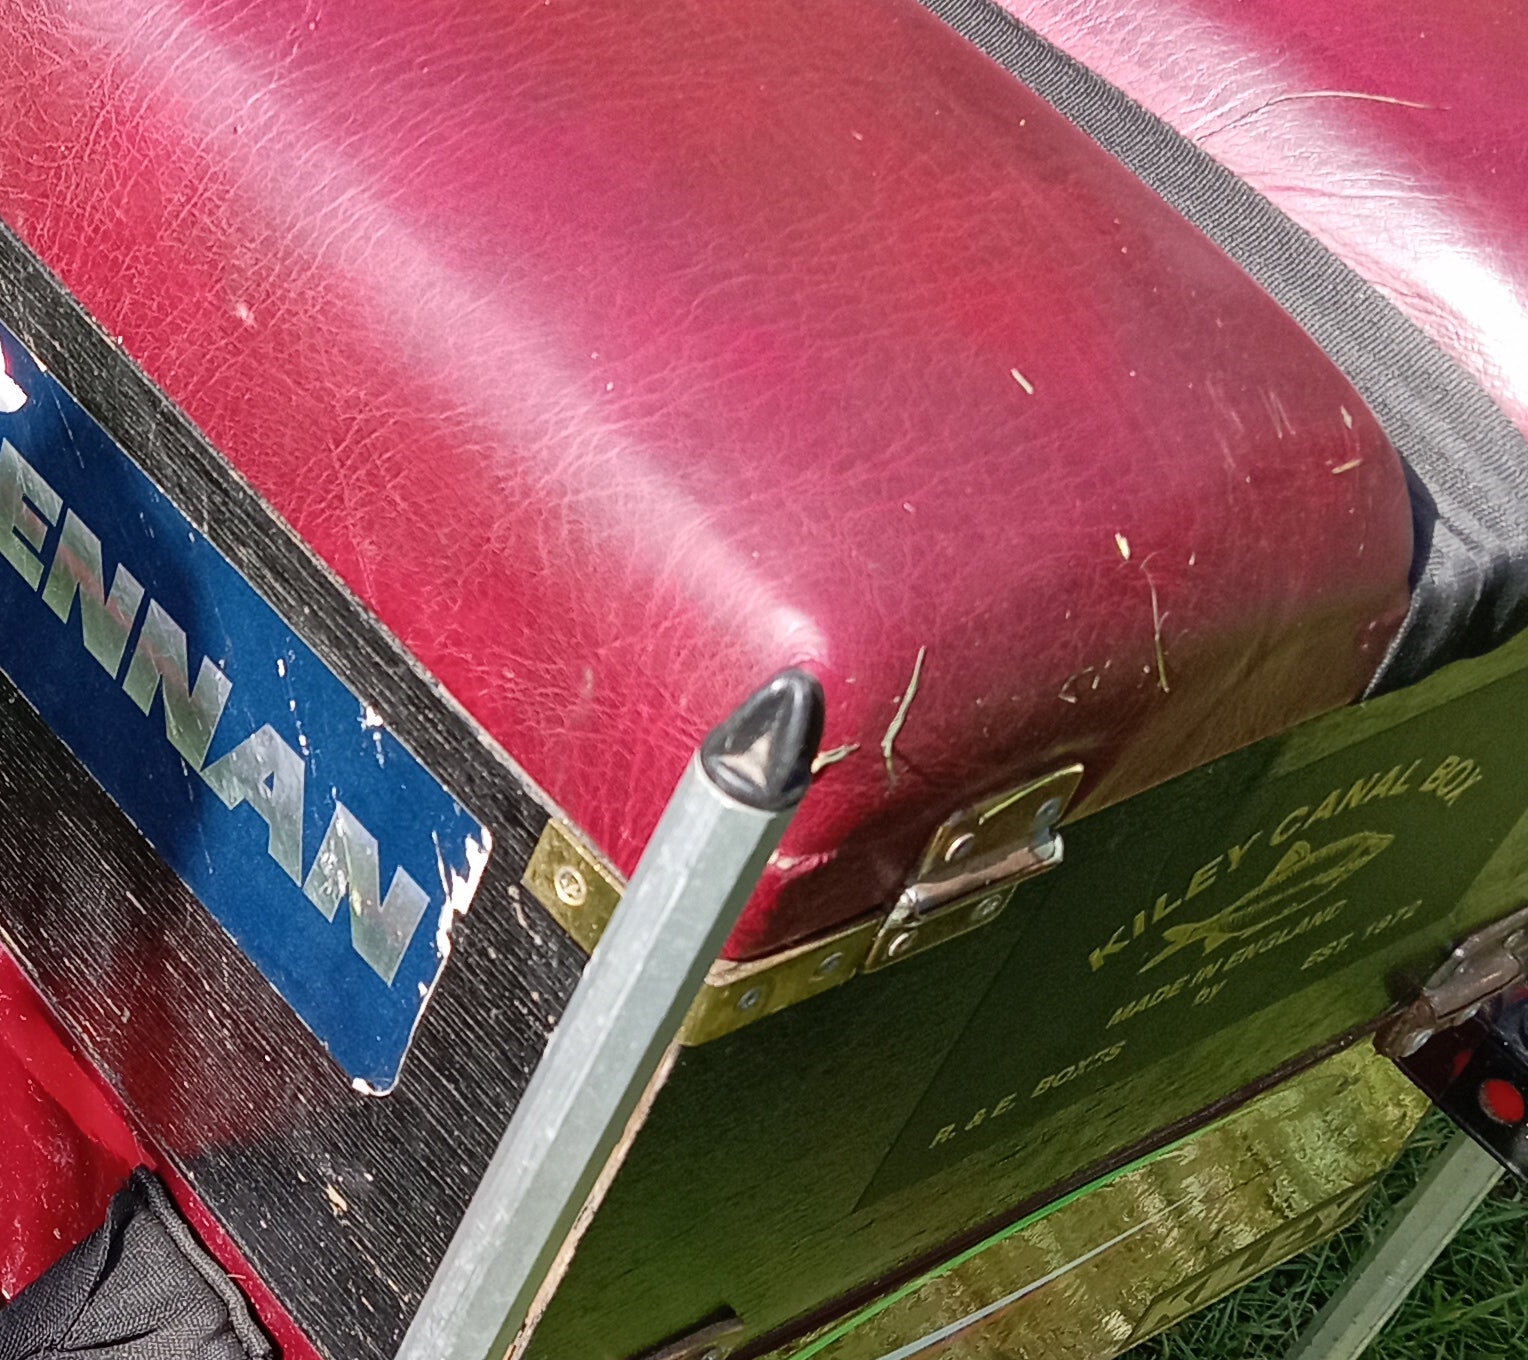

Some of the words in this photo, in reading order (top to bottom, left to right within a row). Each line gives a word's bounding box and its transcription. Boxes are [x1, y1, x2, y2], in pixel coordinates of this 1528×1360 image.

[1088, 830, 1263, 972] KILEY
[1269, 759, 1422, 846] CANAL
[1418, 754, 1483, 808] BOX
[1105, 974, 1190, 1030] MADE
[1189, 958, 1223, 987] IN
[1223, 900, 1347, 971] ENGLAND
[1191, 979, 1228, 1007] by
